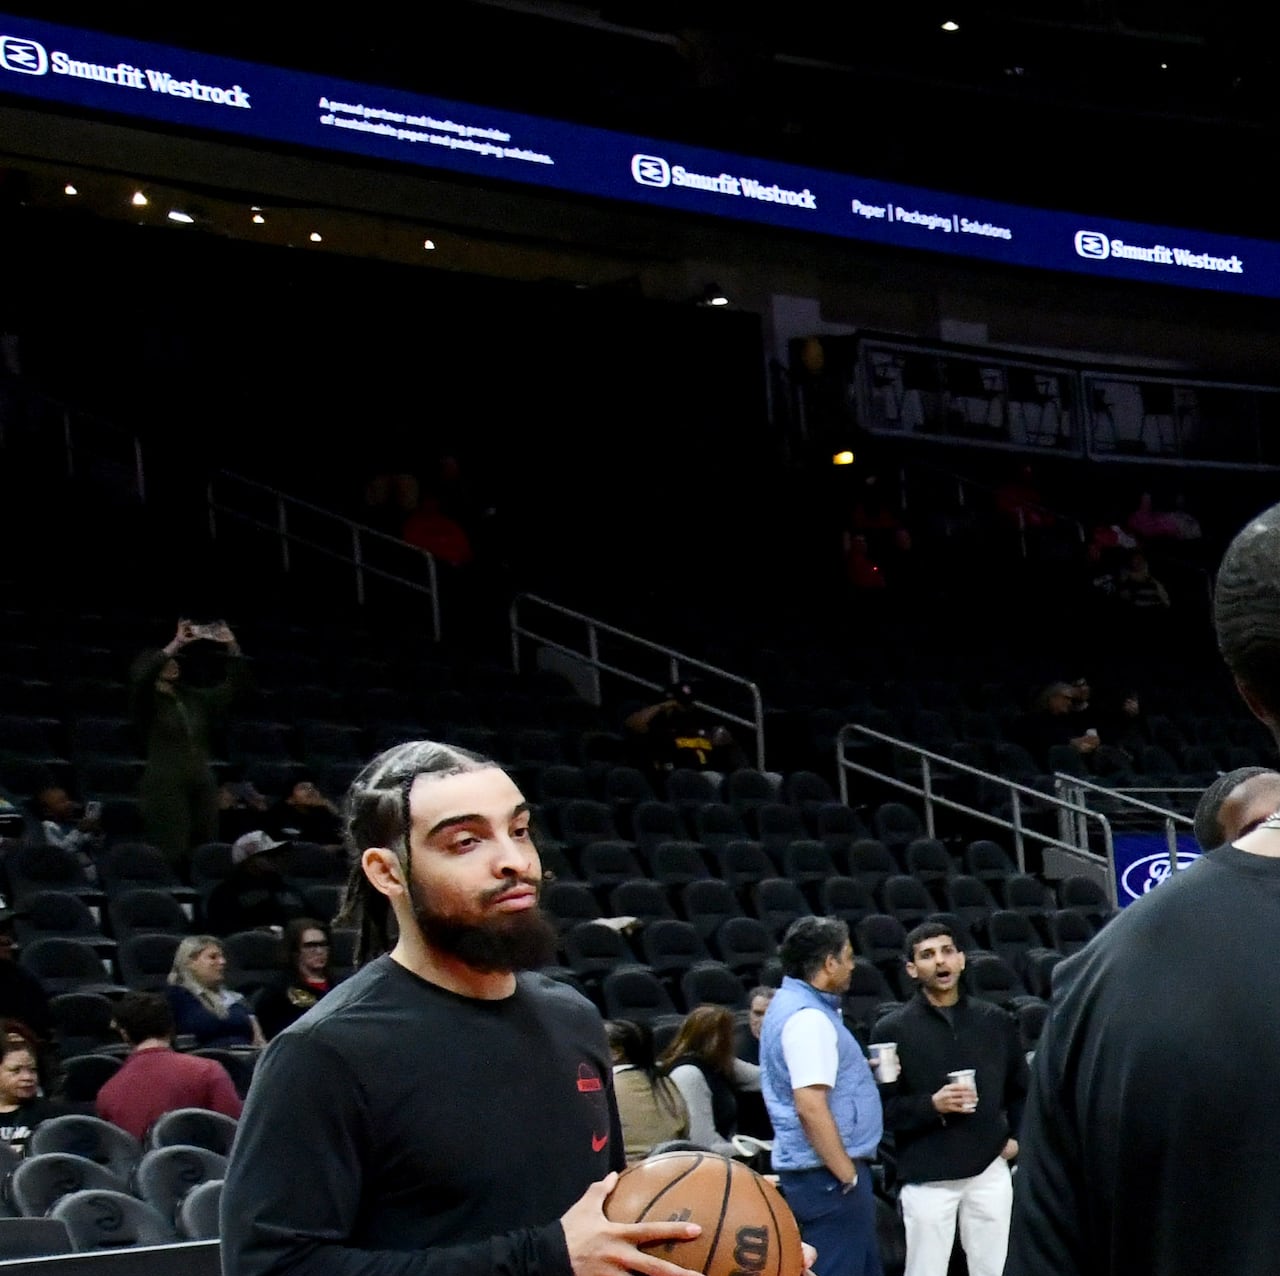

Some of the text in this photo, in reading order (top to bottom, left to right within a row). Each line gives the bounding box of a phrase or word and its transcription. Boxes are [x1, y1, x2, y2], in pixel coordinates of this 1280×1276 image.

[51, 51, 251, 108] Smurfit Westrock
[672, 166, 816, 209] Smurfit Westrock
[852, 200, 1011, 239] Paper Packaging Solutions
[1111, 240, 1243, 273] Smurfit Westrock
